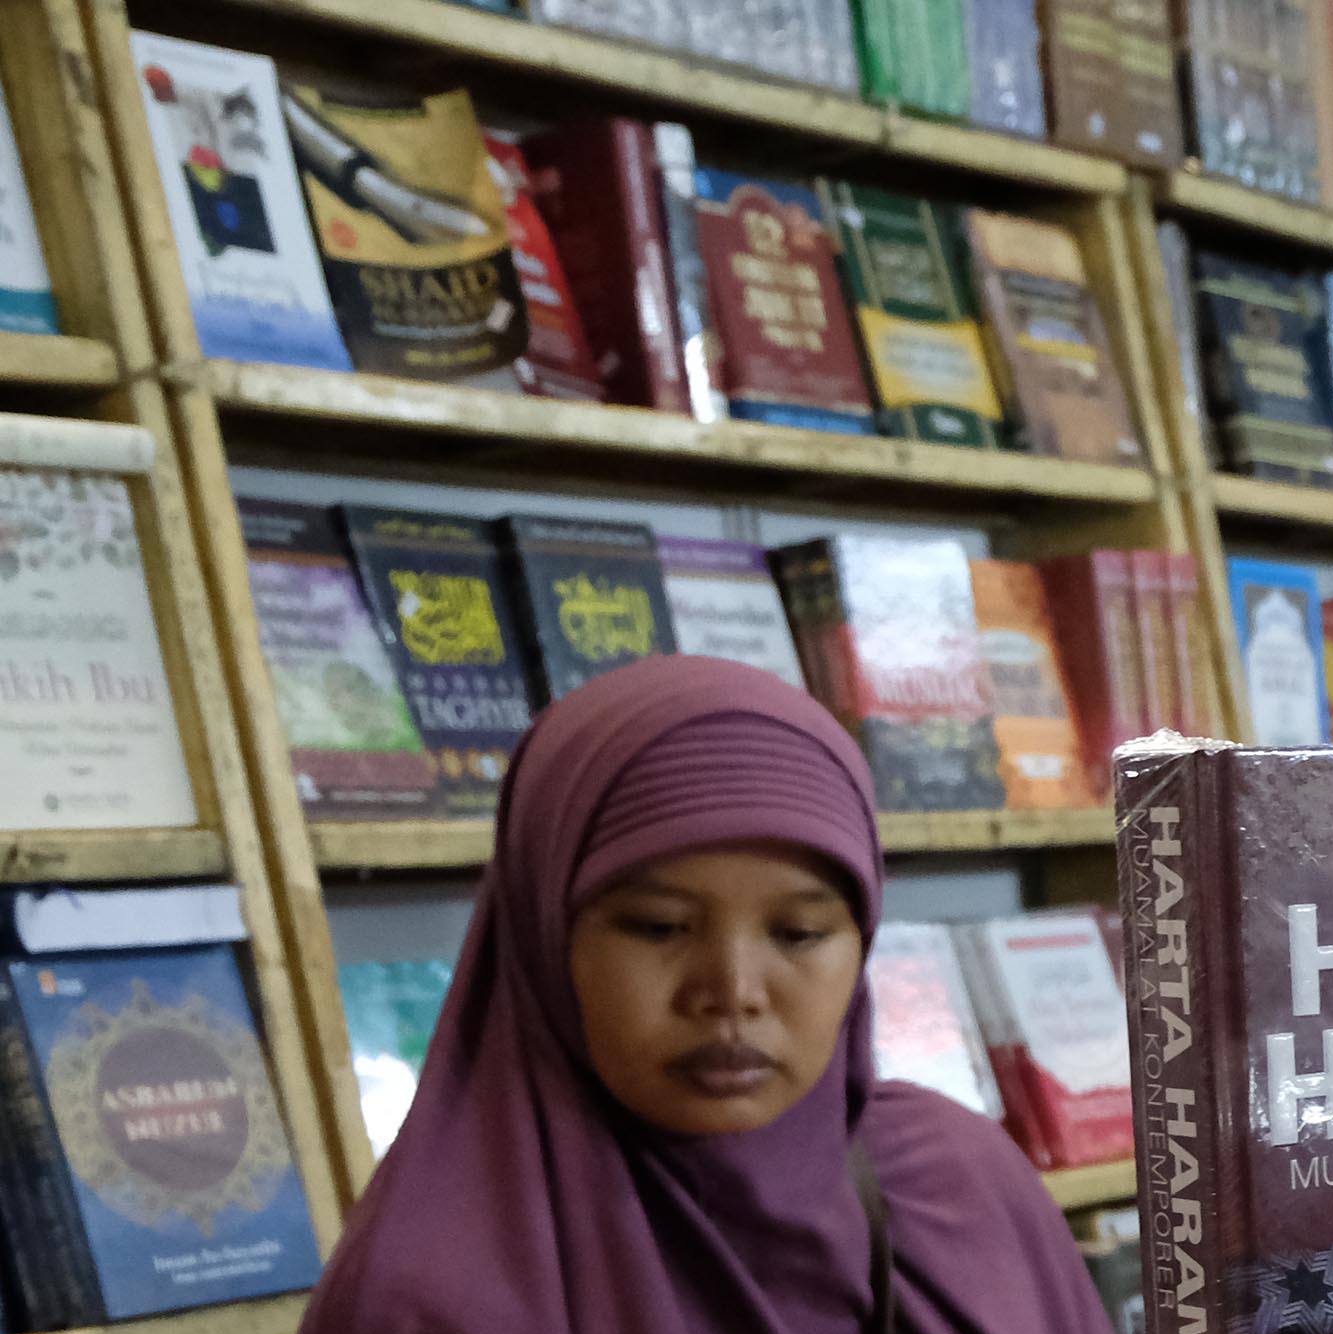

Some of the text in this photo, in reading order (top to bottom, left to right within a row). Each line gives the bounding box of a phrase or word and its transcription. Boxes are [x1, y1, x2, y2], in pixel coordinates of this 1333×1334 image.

[1129, 808, 1175, 1310] MUAMALAT KONTEMPORER
[1150, 805, 1193, 1064] HARTA
